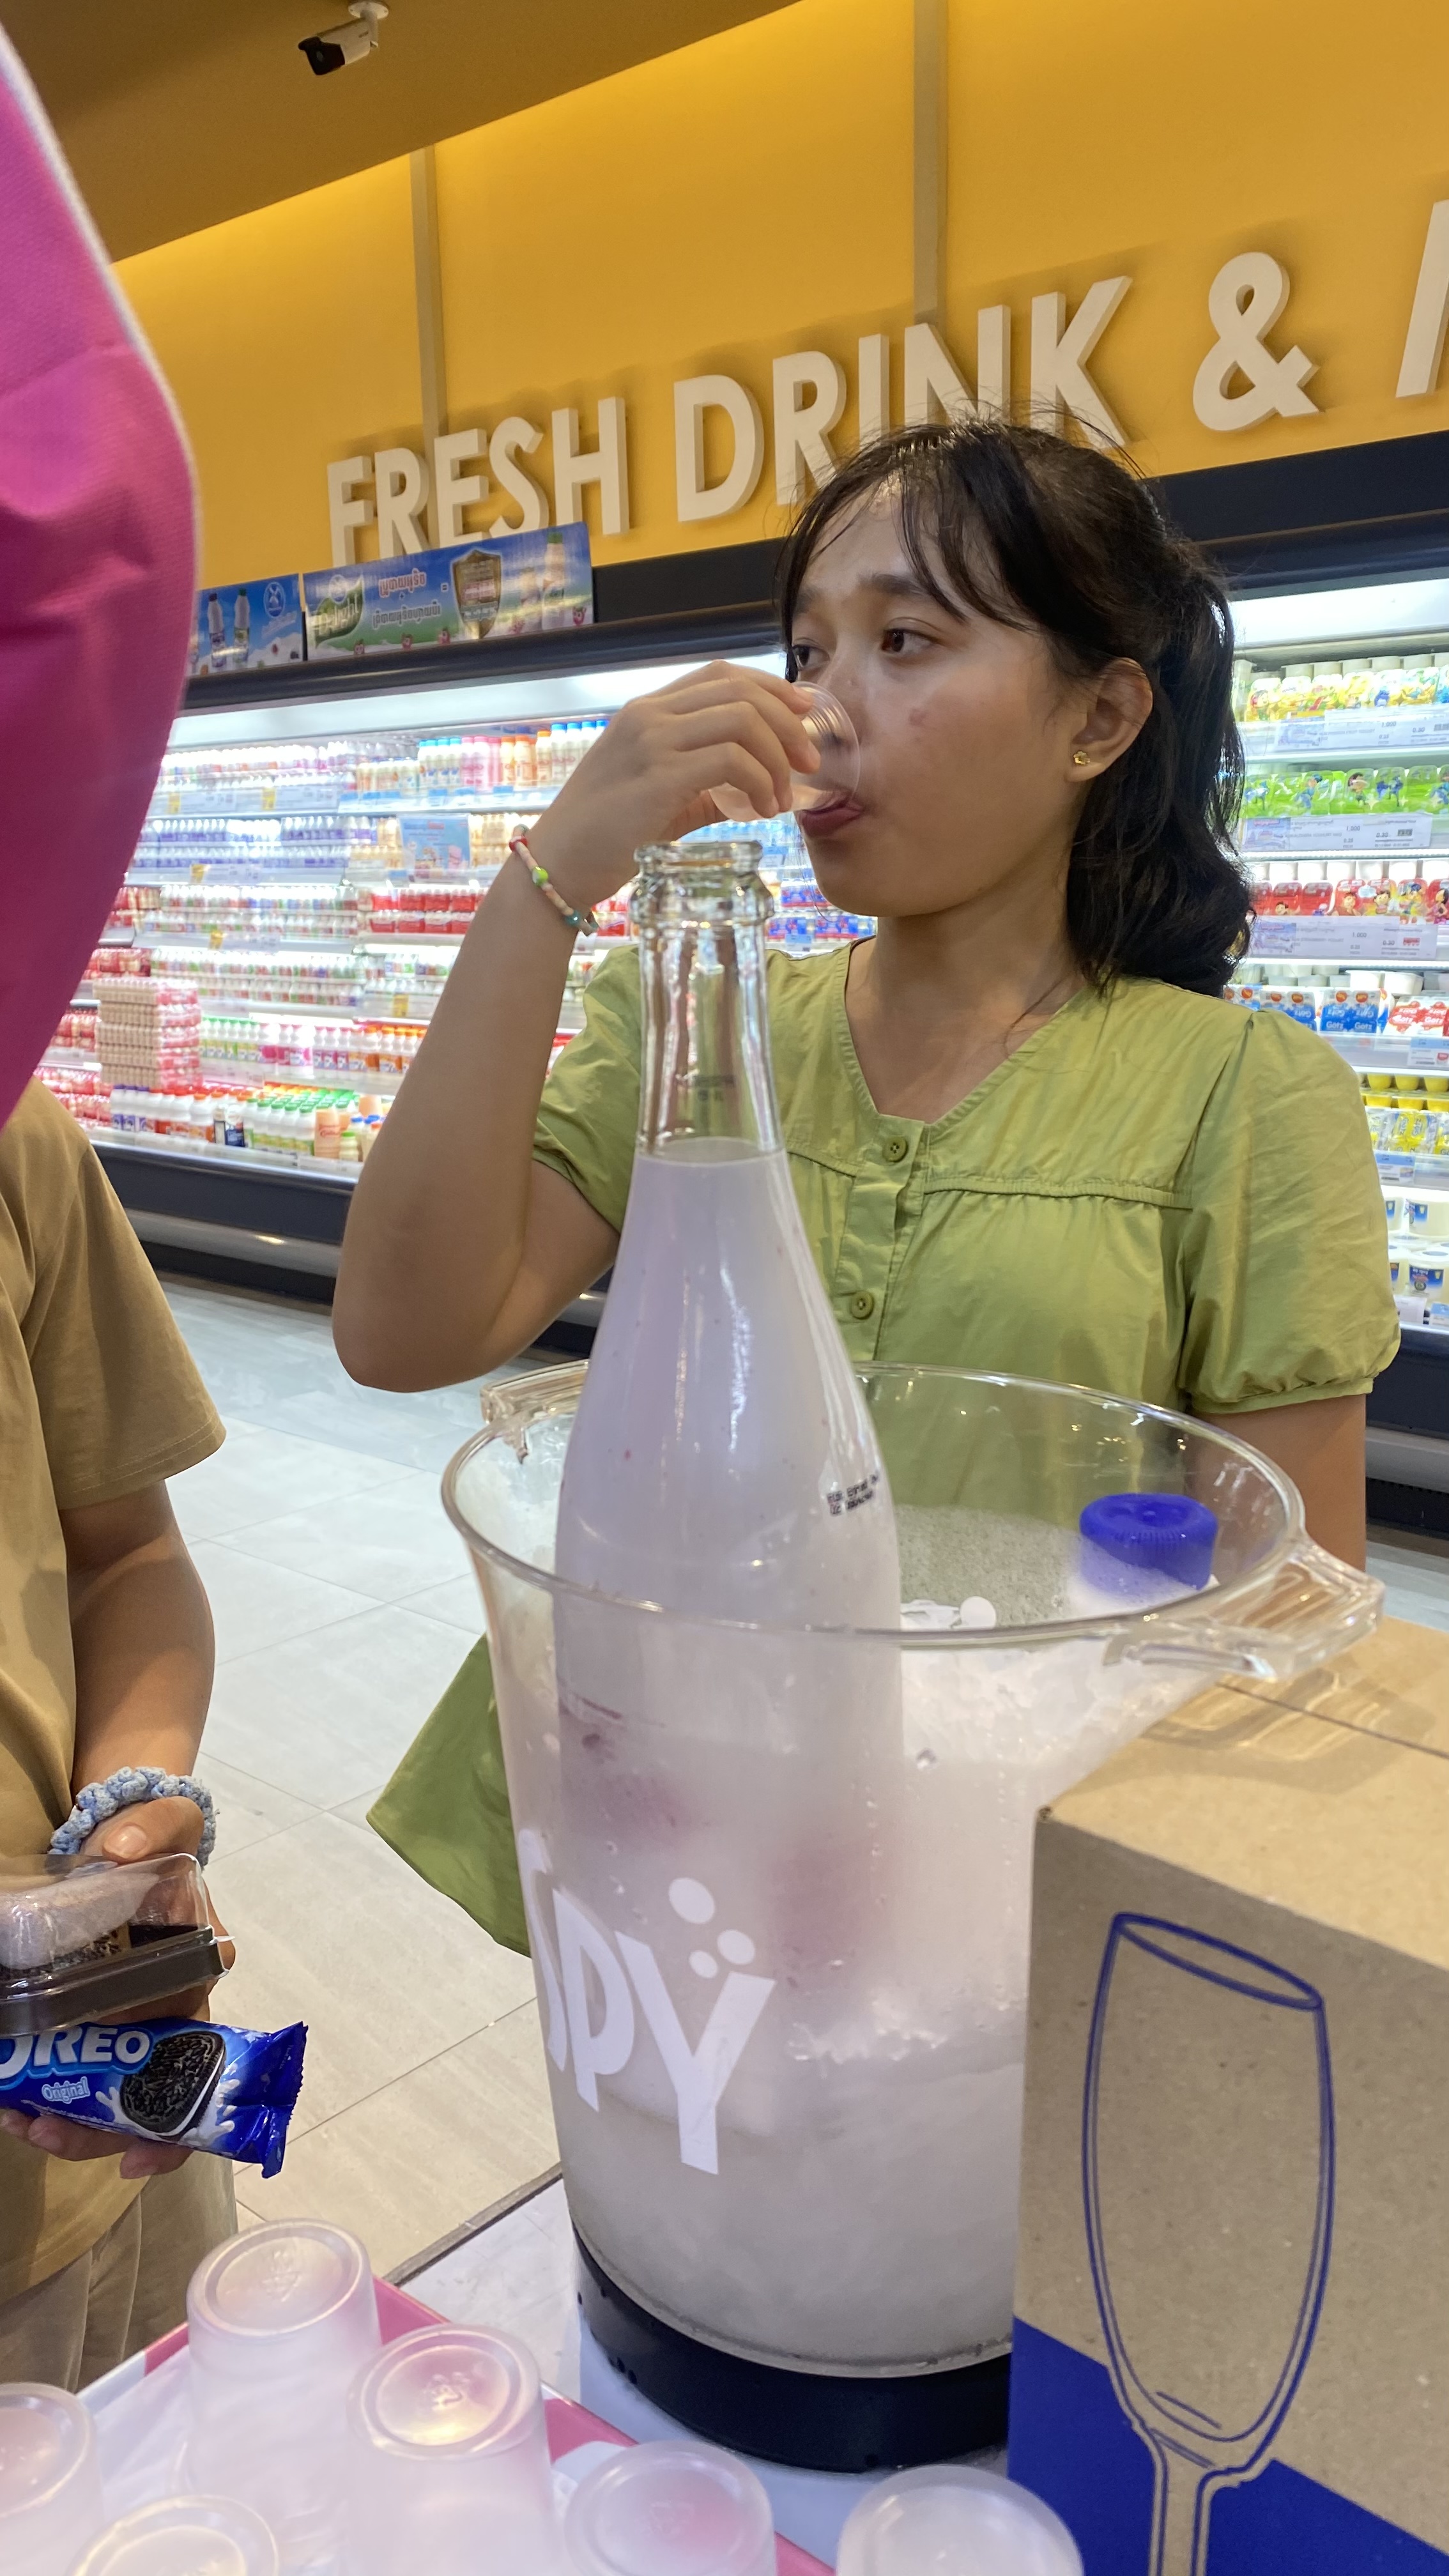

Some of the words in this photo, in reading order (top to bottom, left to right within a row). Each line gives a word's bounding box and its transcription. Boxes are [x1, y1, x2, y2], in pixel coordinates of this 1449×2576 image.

[327, 396, 630, 567] FRESH
[674, 275, 1133, 523] DRINK
[1193, 251, 1326, 432] &
[42, 2077, 90, 2104] Original
